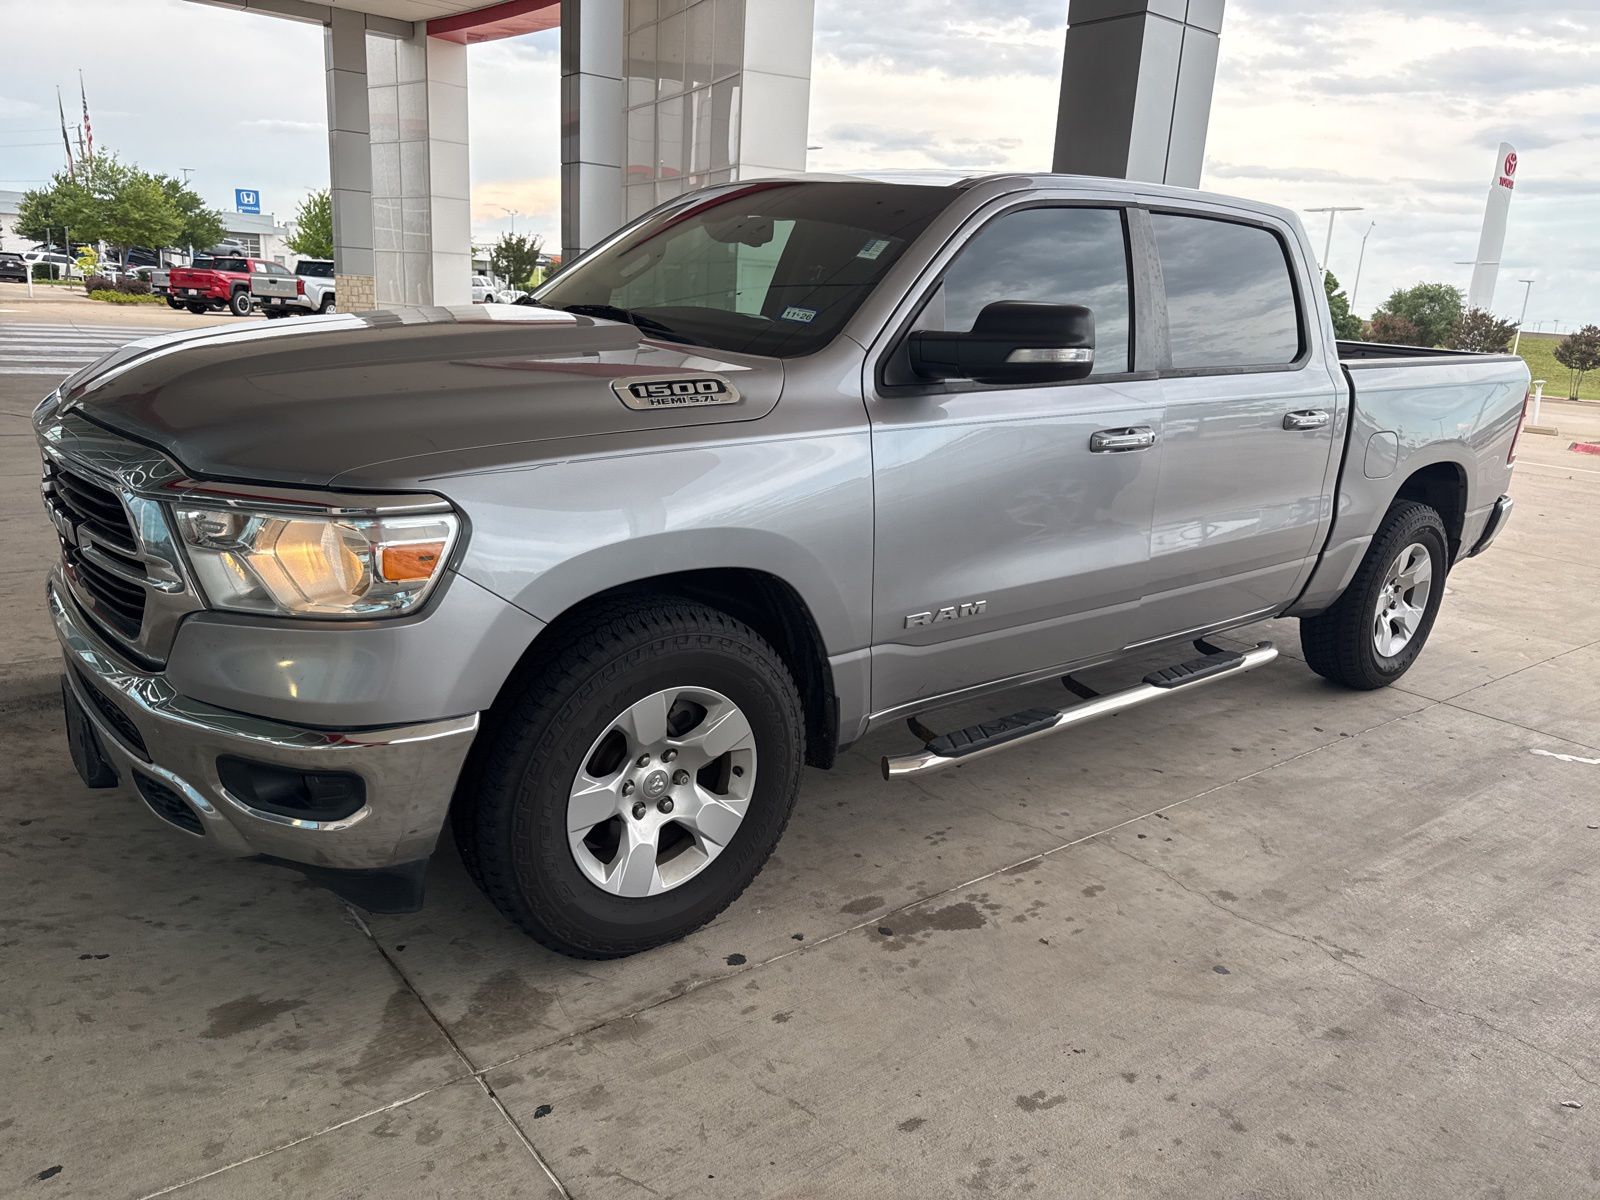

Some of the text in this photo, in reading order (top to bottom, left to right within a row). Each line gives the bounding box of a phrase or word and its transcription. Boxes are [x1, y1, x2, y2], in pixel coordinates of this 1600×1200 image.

[635, 381, 719, 397] 1500
[650, 397, 687, 405] HEMI
[904, 600, 986, 629] RAM
